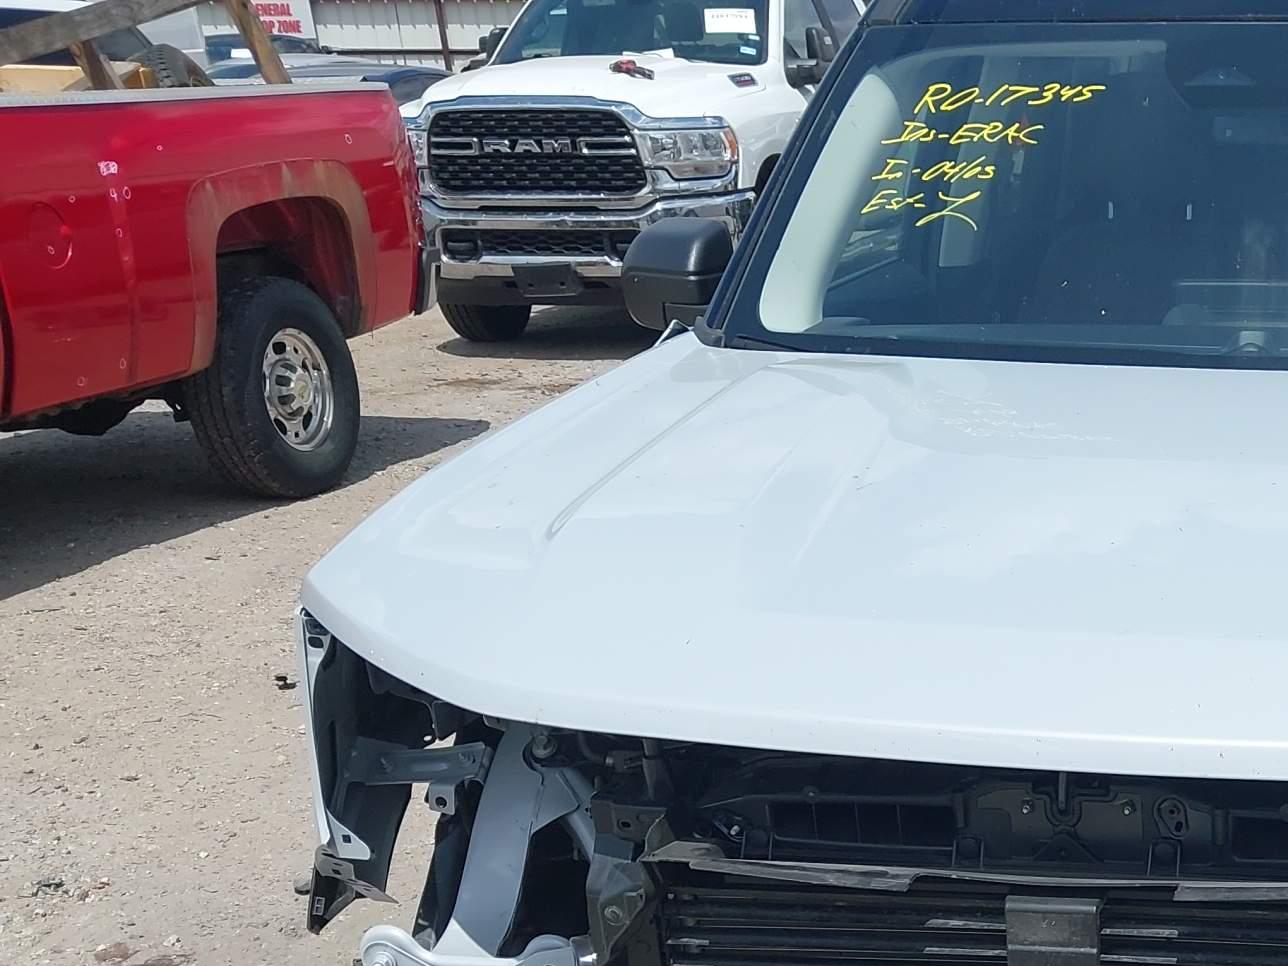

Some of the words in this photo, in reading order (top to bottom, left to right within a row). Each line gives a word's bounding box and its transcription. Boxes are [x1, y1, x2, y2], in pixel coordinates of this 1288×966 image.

[254, 3, 292, 17] ENERAL
[277, 20, 303, 34] ZONE
[482, 136, 572, 153] RAM
